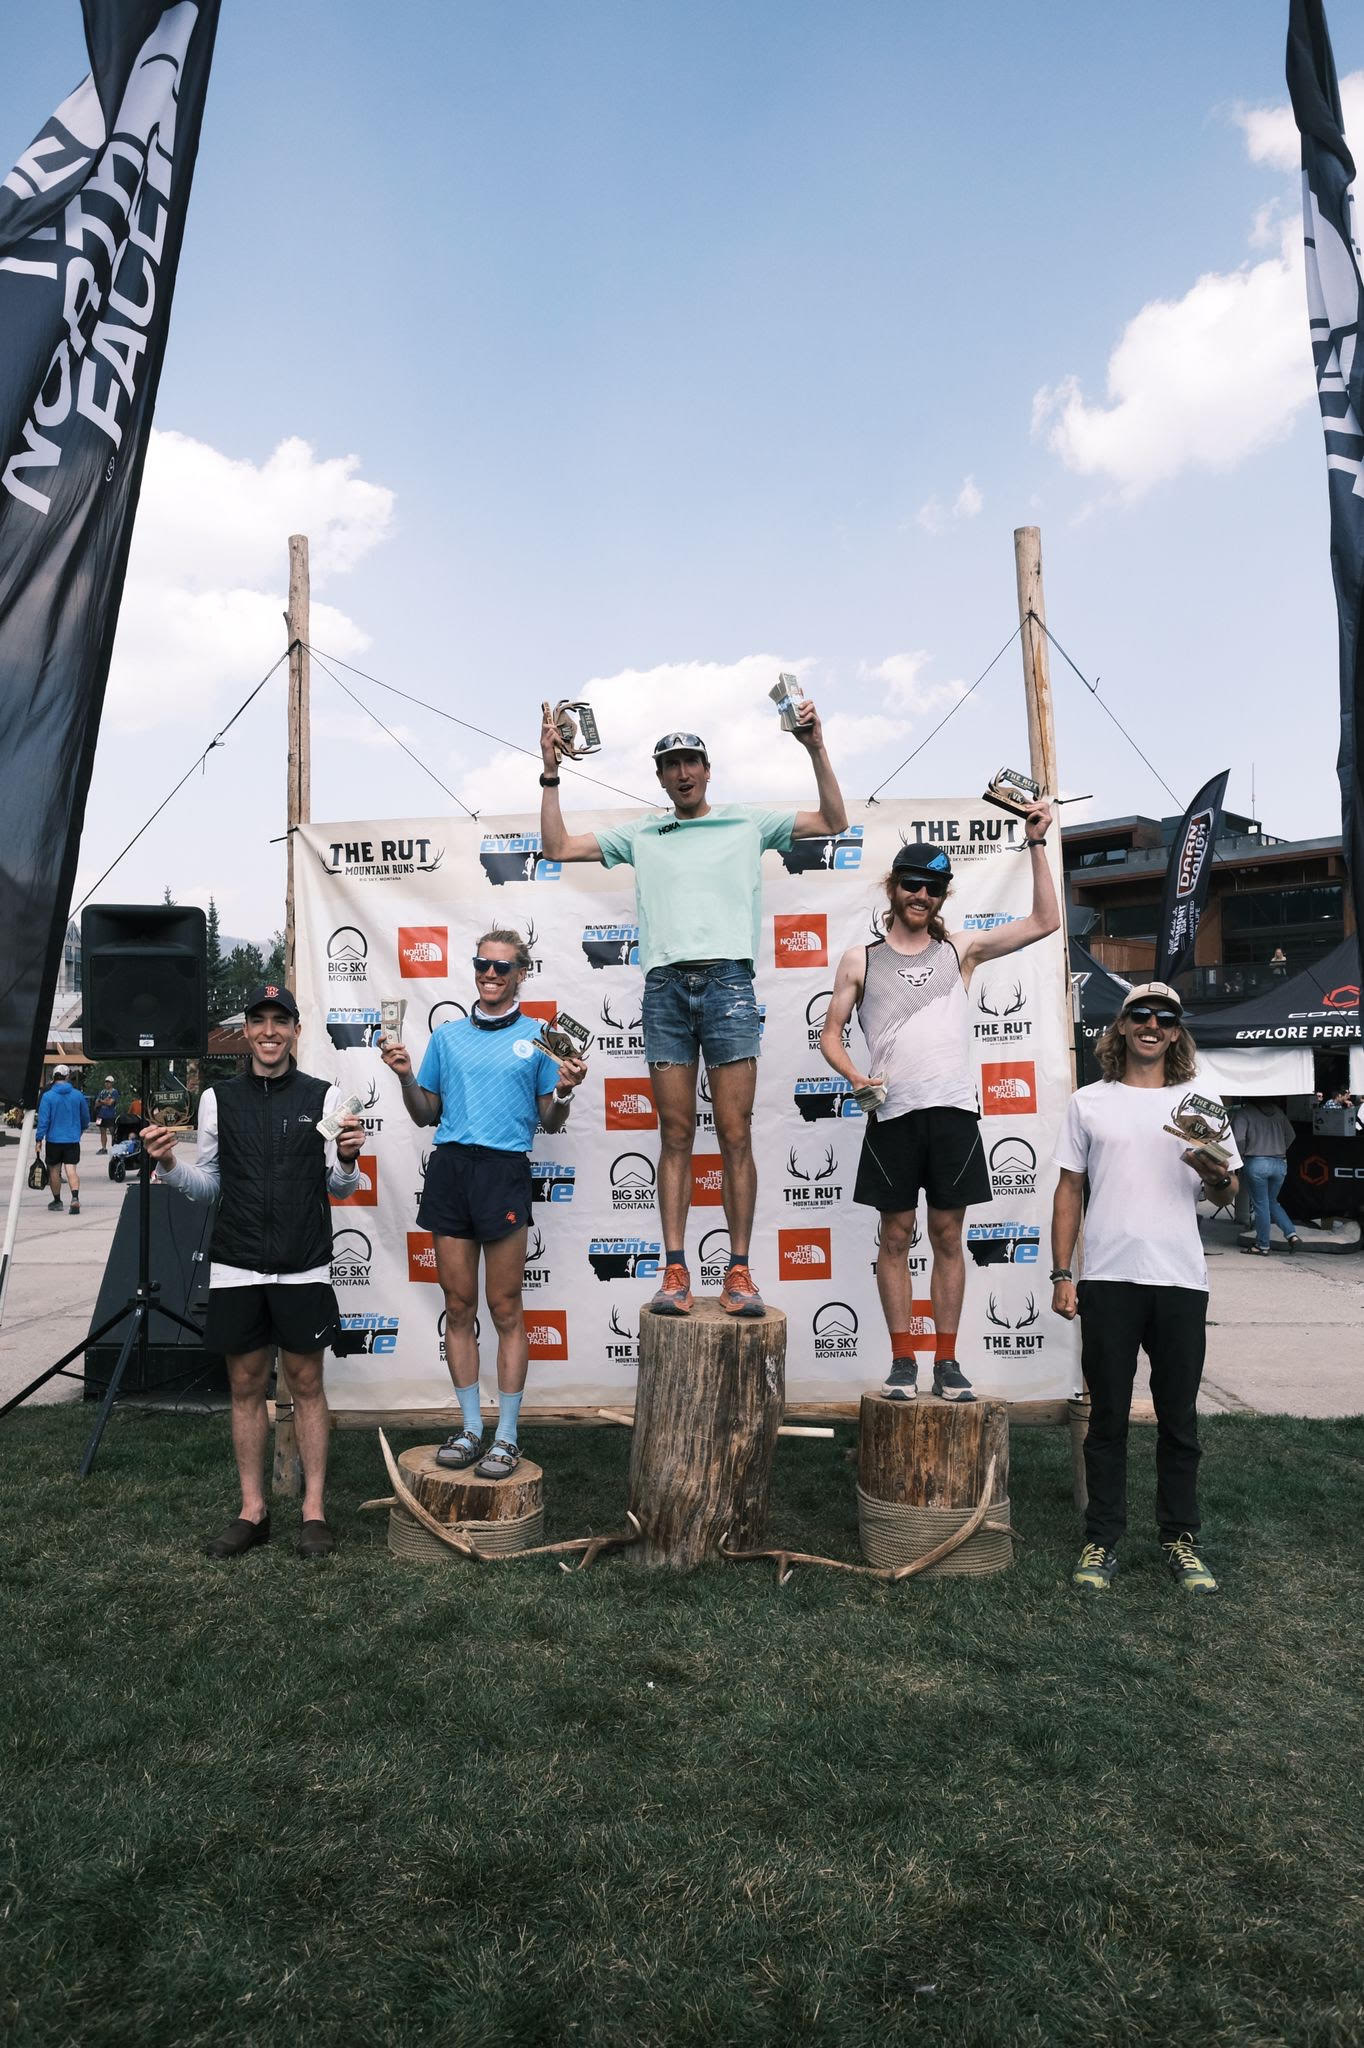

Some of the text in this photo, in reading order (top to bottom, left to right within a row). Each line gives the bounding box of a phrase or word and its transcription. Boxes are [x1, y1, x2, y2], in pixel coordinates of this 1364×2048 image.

[77, 195, 168, 450] FACE
[658, 821, 681, 836] HOKA
[911, 819, 1018, 844] THE RUT
[480, 839, 542, 851] even
[936, 844, 1002, 855] OUNTAIN RUNS
[329, 839, 431, 866] THE RUT
[1180, 825, 1198, 887] DARN
[1190, 823, 1206, 888] TOUGH
[345, 864, 414, 876] MOUNTAIN RUNS
[963, 916, 1024, 929] event
[583, 928, 639, 940] event
[1170, 905, 1187, 955] VERMONT
[328, 962, 368, 972] BIG SKY
[326, 1011, 381, 1023] event
[560, 1016, 574, 1029] THE
[574, 1026, 588, 1039] RUT
[974, 1022, 1032, 1037] THE RUT
[1235, 1026, 1308, 1039] EXPLORE
[597, 1036, 645, 1050] THE RU
[795, 1081, 853, 1094] event
[610, 1100, 638, 1108] NORTH
[1192, 1097, 1208, 1108] THE
[1209, 1105, 1226, 1117] RUT
[696, 1113, 714, 1127] TH
[1195, 1123, 1206, 1135] VK
[531, 1166, 575, 1177] ents
[992, 1174, 1036, 1185] BIG SKY
[612, 1189, 656, 1200] BIG SKY
[783, 1187, 842, 1202] THE RUT
[967, 1225, 1040, 1239] events
[588, 1241, 660, 1253] events
[350, 1266, 371, 1276] SKY
[701, 1266, 721, 1276] BIG
[909, 1258, 927, 1271] UT
[340, 1316, 399, 1329] vents
[815, 1338, 858, 1349] BIG SKY
[983, 1336, 1044, 1349] THE RUT
[605, 1345, 632, 1358] THE
